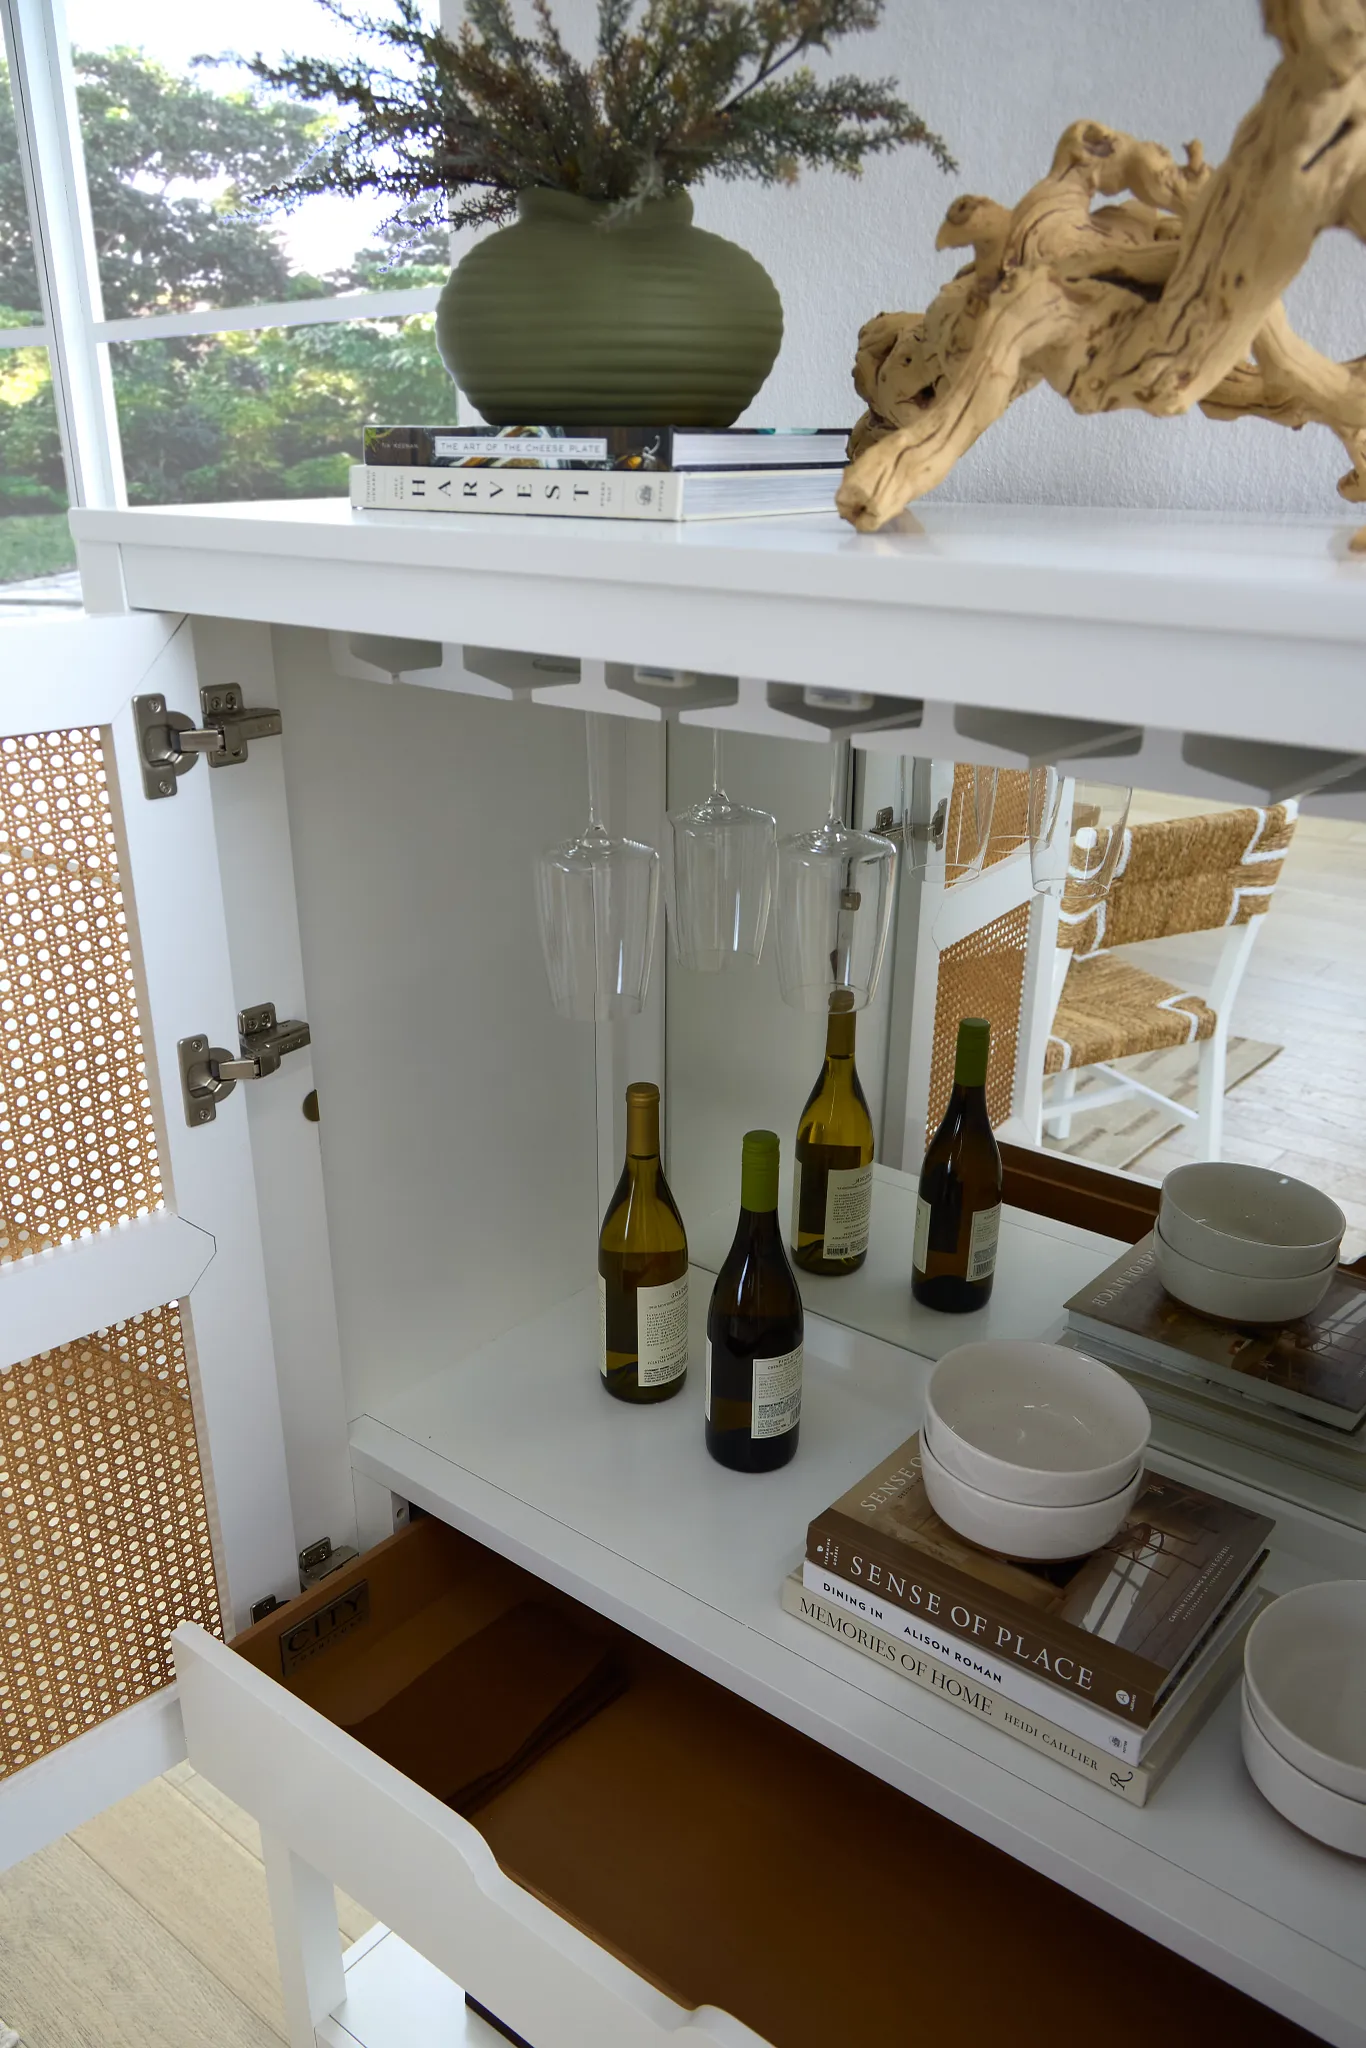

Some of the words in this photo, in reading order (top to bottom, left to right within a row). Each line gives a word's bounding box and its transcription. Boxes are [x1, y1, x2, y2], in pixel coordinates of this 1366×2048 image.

[441, 442, 459, 451] THE
[464, 443, 482, 451] ART
[486, 443, 498, 451] OF
[504, 443, 521, 452] THE
[526, 443, 564, 453] CHEESE
[569, 444, 600, 454] PLATE
[412, 480, 589, 502] HARVEST
[860, 1467, 916, 1512] SENSE
[288, 1591, 366, 1653] CITY
[823, 1582, 866, 1611] DINING
[870, 1607, 883, 1620] IN
[850, 1555, 941, 1615] SENSE
[950, 1605, 992, 1637] OF
[995, 1626, 1093, 1690] PLACE
[799, 1597, 897, 1662] MEMORIES
[900, 1654, 928, 1680] OF
[931, 1670, 993, 1717] HOME
[904, 1626, 951, 1657] ALISON
[954, 1652, 1003, 1684] ROMAN
[1004, 1712, 1038, 1738] HEIDI
[1042, 1731, 1098, 1771] CAILLIER
